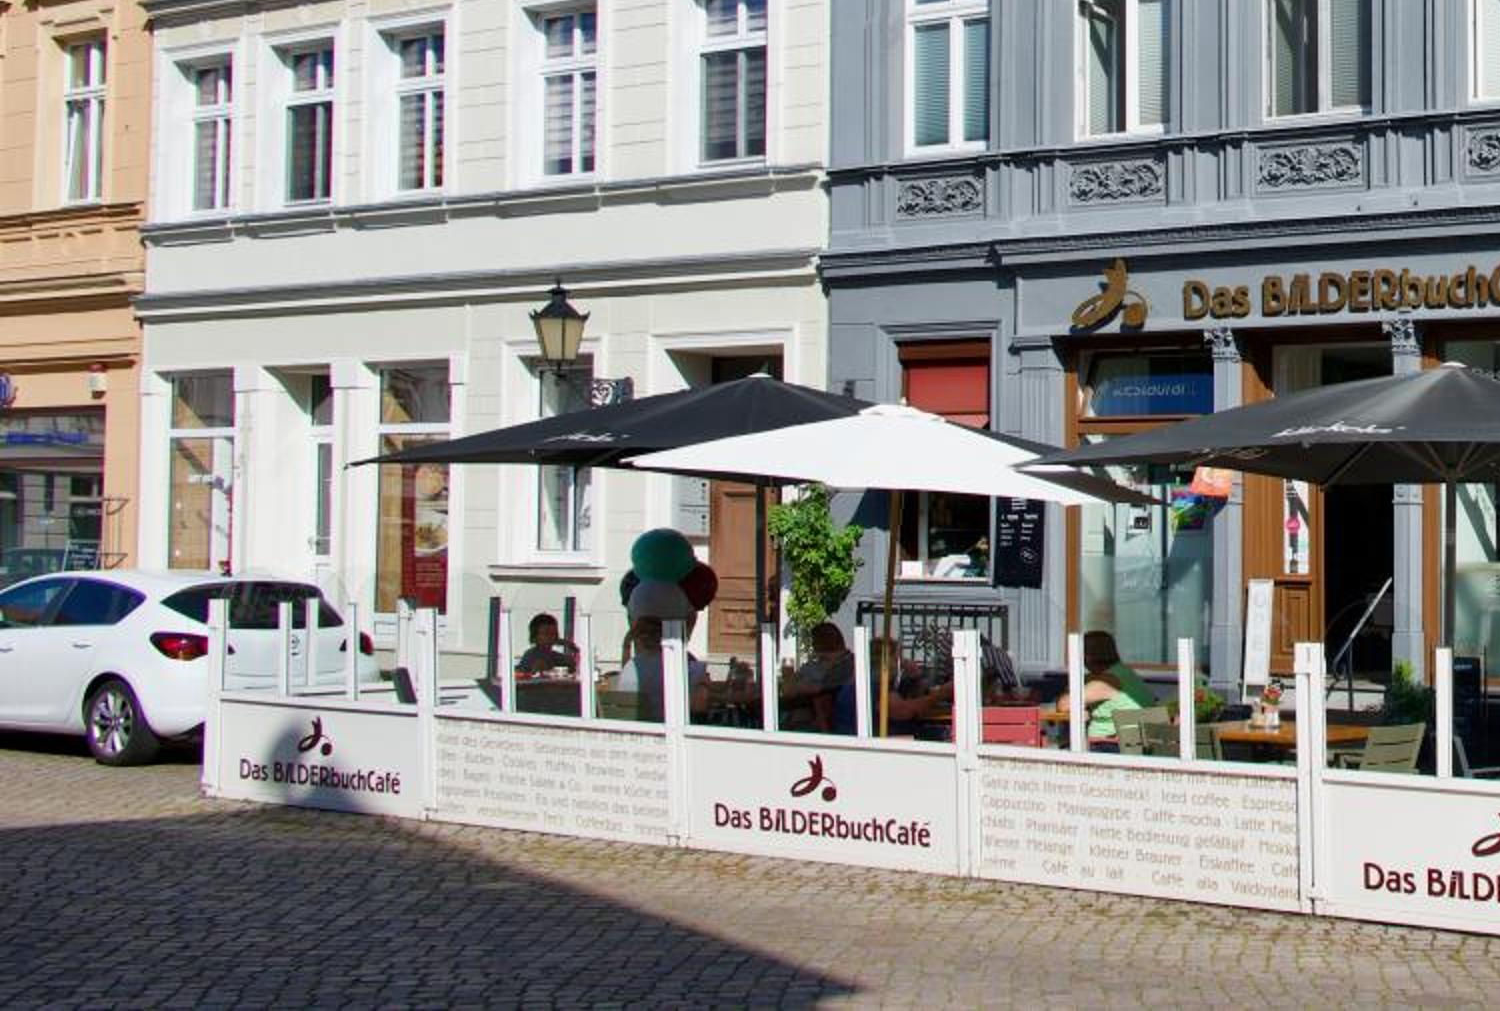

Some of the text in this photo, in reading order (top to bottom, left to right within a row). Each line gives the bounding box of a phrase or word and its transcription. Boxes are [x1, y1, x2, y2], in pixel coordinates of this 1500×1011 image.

[1184, 280, 1250, 319] Das
[240, 758, 268, 781] Das
[715, 802, 752, 830] Das
[1363, 861, 1416, 894] Das
